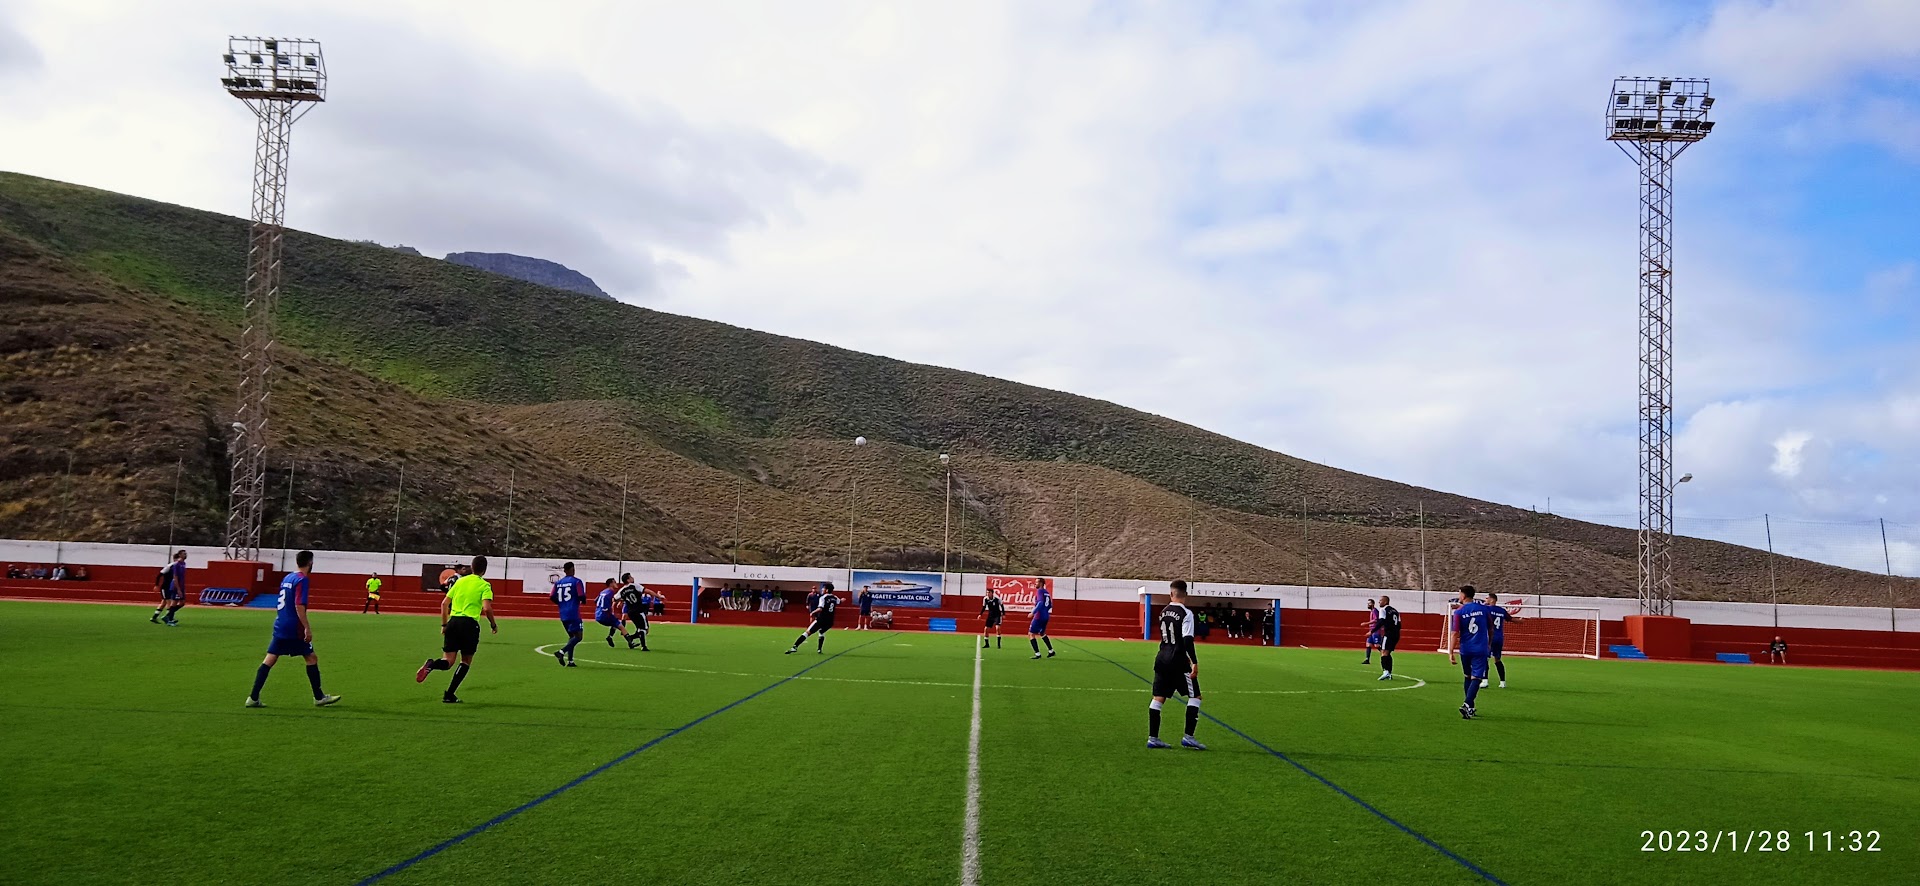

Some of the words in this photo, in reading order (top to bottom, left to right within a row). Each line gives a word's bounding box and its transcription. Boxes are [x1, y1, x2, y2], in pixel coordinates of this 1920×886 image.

[277, 589, 286, 610] 3
[557, 587, 572, 602] 15
[625, 593, 638, 605] 10
[1044, 597, 1050, 607] 8
[1392, 614, 1398, 625] 9
[1468, 617, 1479, 634] 6
[1493, 617, 1501, 629] 4
[1160, 621, 1176, 644] 11
